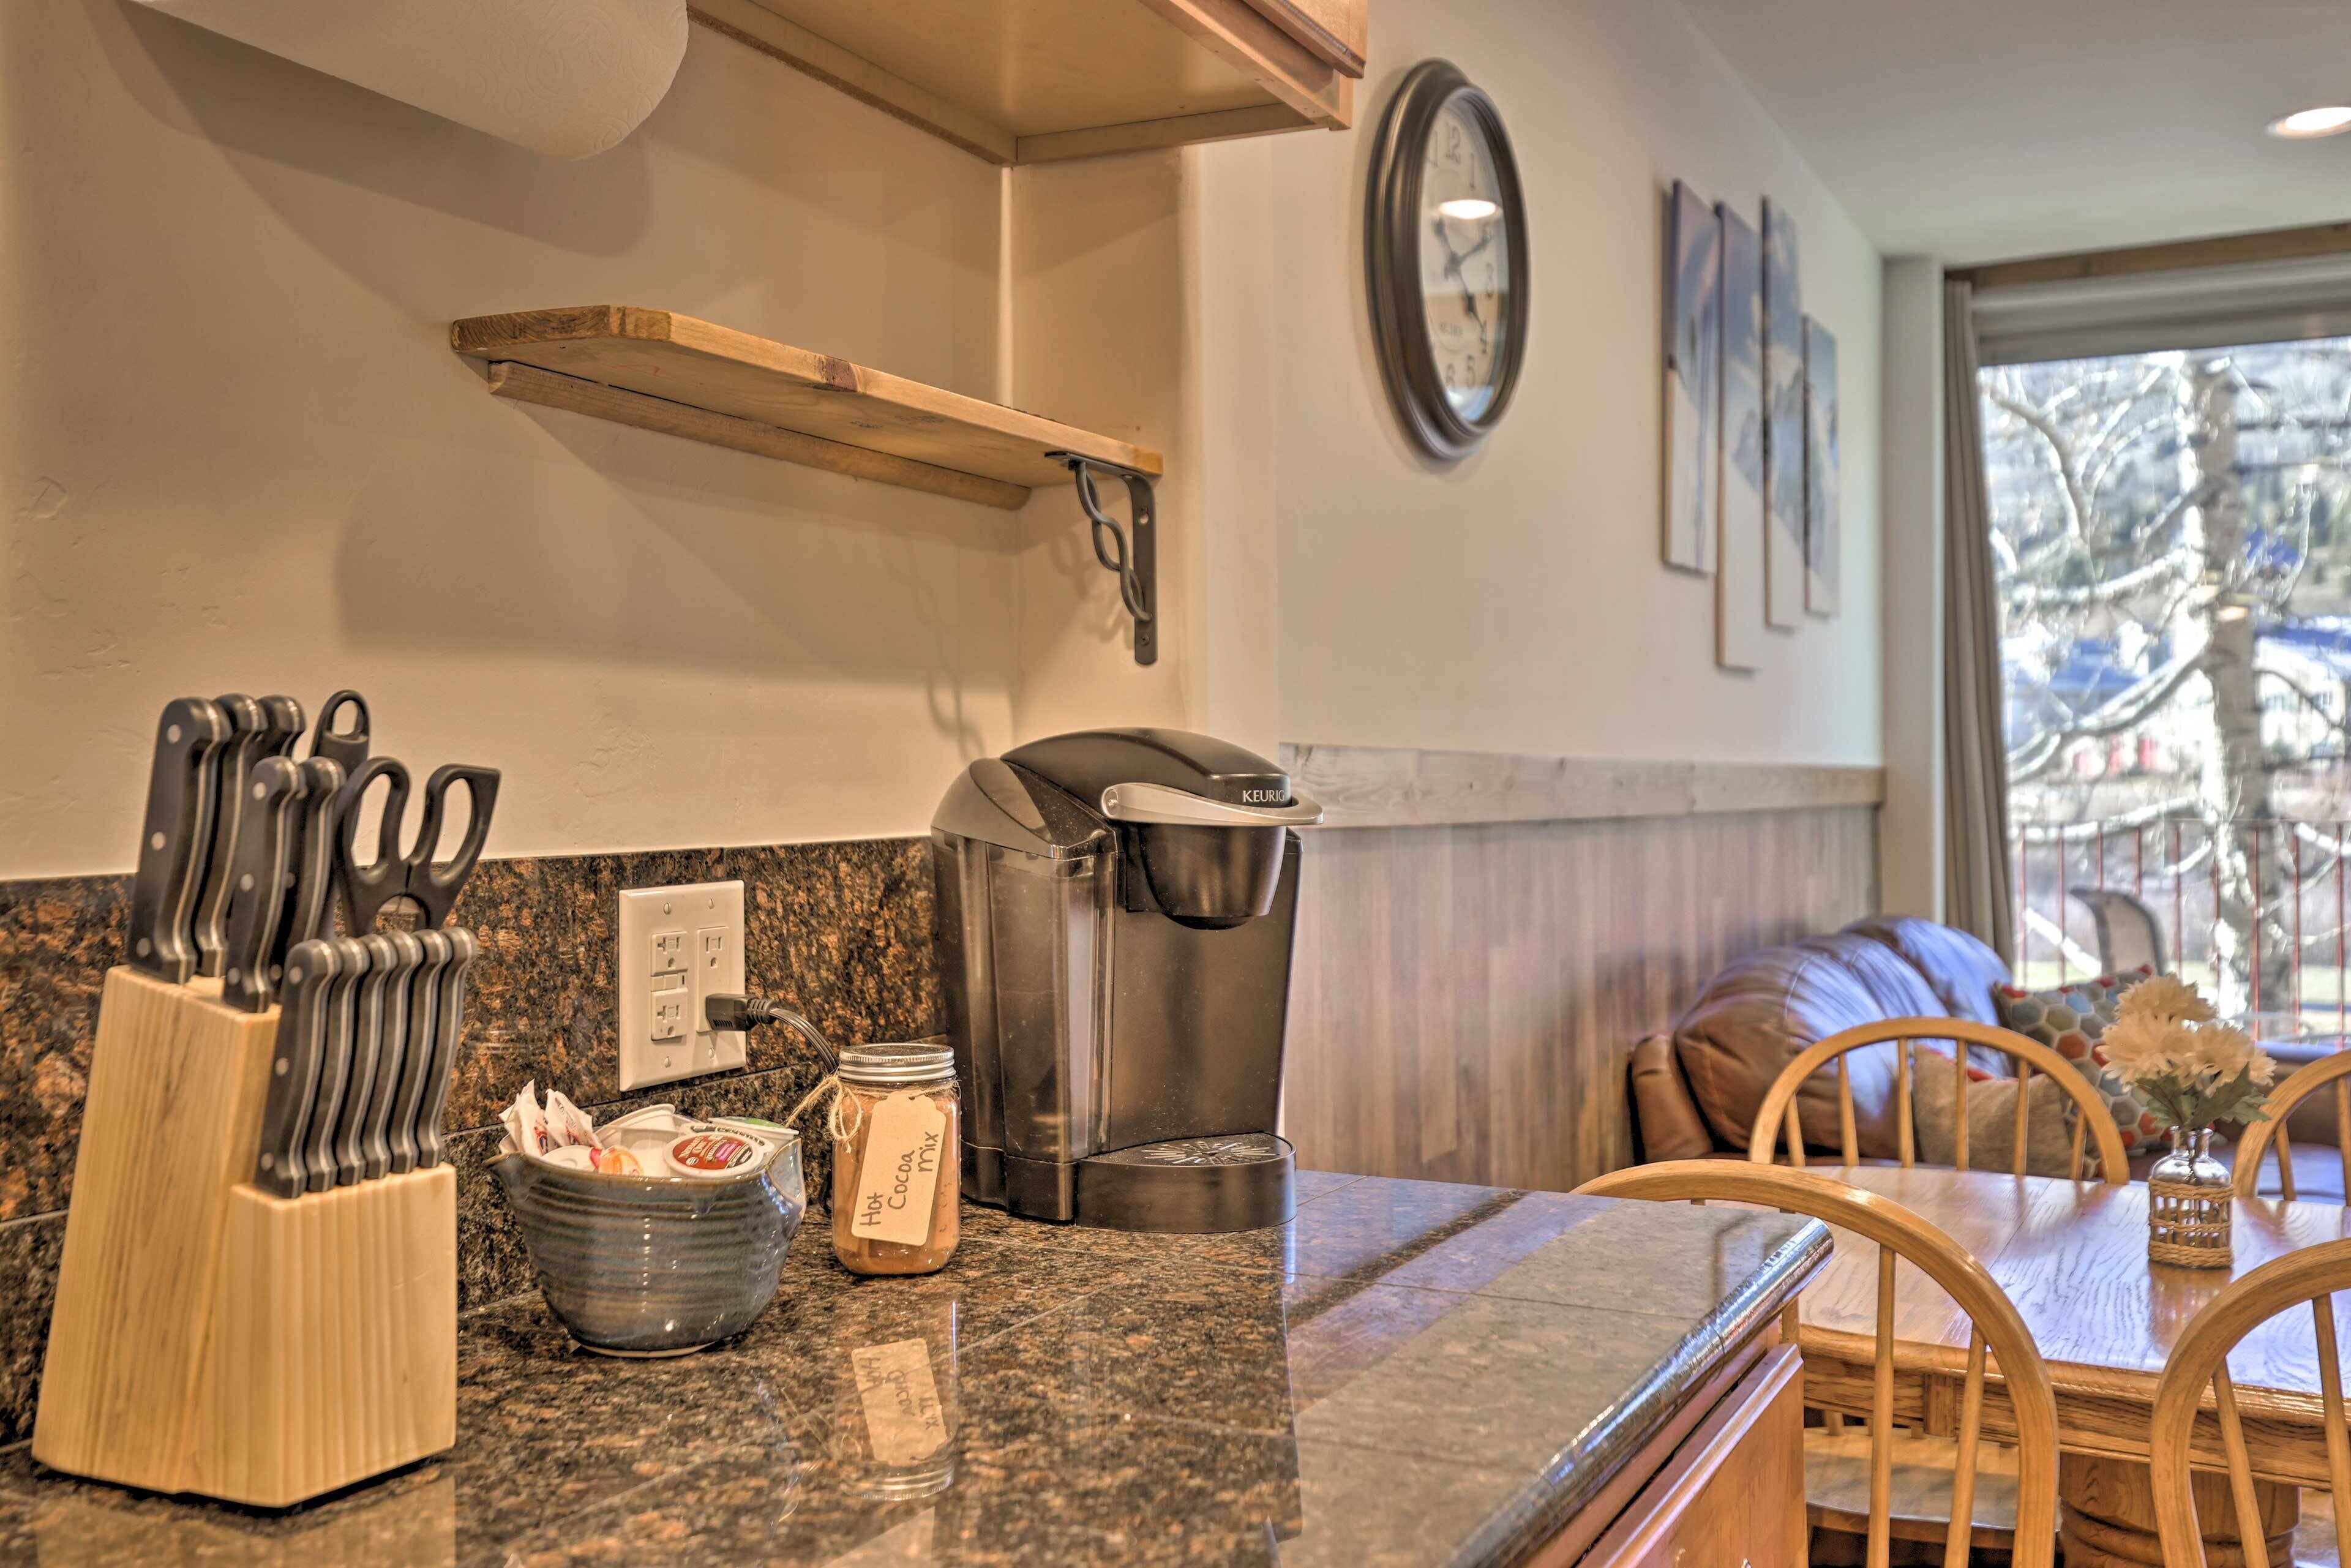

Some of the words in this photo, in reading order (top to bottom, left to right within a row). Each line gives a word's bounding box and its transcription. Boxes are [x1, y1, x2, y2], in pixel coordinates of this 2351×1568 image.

[1243, 790, 1285, 802] KEURIG
[888, 1150, 915, 1209] Cocoa
[860, 1192, 883, 1226] Hot
